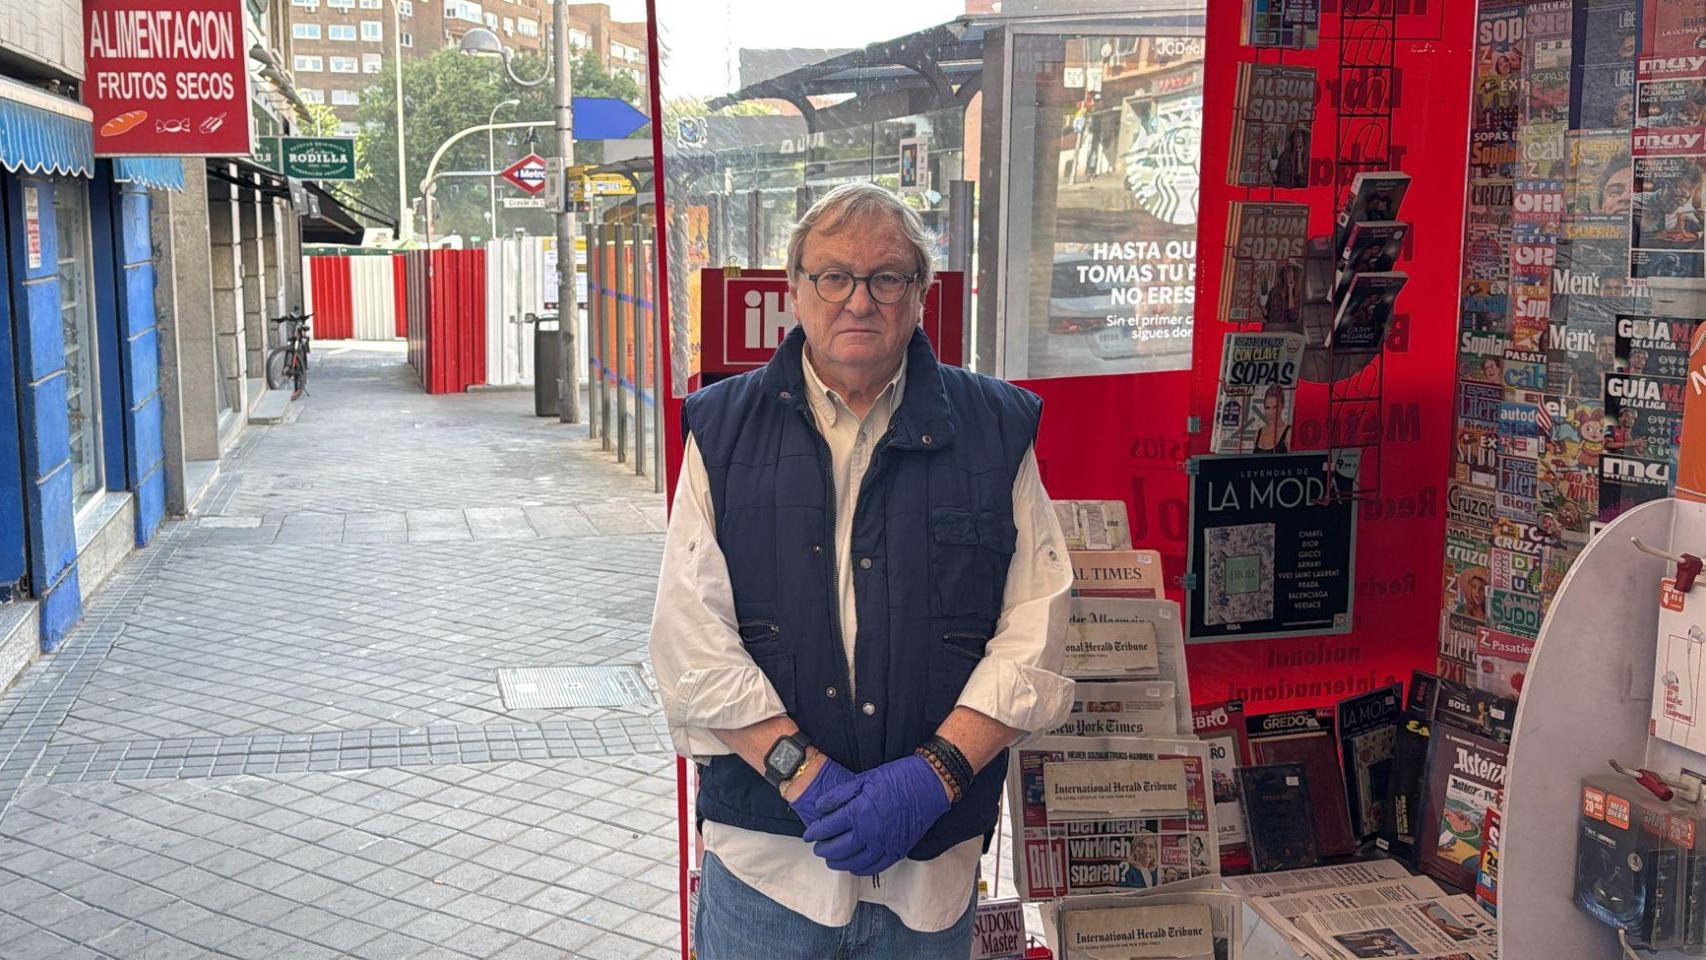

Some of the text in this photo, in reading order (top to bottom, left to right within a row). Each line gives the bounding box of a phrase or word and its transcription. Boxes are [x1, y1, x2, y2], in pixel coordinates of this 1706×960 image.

[89, 10, 235, 60] ALIMENTACION
[97, 71, 235, 100] FRUTOS SECOS
[1531, 71, 1563, 82] SOPAS
[1252, 78, 1315, 99] ALBUM
[1249, 99, 1314, 123] SOPAS
[1474, 131, 1509, 141] SOPAS
[288, 153, 348, 163] RODILLA
[1242, 215, 1306, 235] ALBUM
[1093, 242, 1160, 260] HASTA
[1240, 237, 1303, 258] SOPAS
[1076, 264, 1184, 283] TOMAS TU
[1552, 268, 1601, 296] Men's
[1111, 285, 1196, 305] NO ERES
[1106, 315, 1125, 326] Sin
[1127, 315, 1138, 326] el
[1141, 315, 1181, 329] primer
[1618, 317, 1671, 341] GUÍA
[1132, 328, 1169, 341] sigues
[1548, 324, 1596, 353] Men's
[1630, 338, 1676, 350] DE LA LIGA
[1234, 349, 1279, 361] CON CLAVE
[1230, 361, 1294, 385] SOPAS
[1607, 377, 1661, 401] GUÍA
[1620, 397, 1666, 410] DE LA LIGA
[1241, 468, 1309, 478] LEYENDAS DE
[1208, 480, 1240, 511] LA
[1091, 567, 1142, 580] TIMES
[1085, 641, 1113, 653] Herald
[1114, 641, 1149, 652] Tribune
[1448, 699, 1471, 712] BOSS
[1076, 719, 1104, 736] York
[1106, 719, 1144, 733] Times
[1343, 710, 1357, 727] LA
[1055, 781, 1178, 794] International Herald Tribune
[1610, 801, 1627, 813] MEGA
[1028, 843, 1064, 889] Bild
[1071, 861, 1130, 882] sparen?
[973, 910, 1020, 937] SUDOKU
[982, 934, 1018, 954] Master
[1076, 926, 1203, 944] International Herald Tribune
